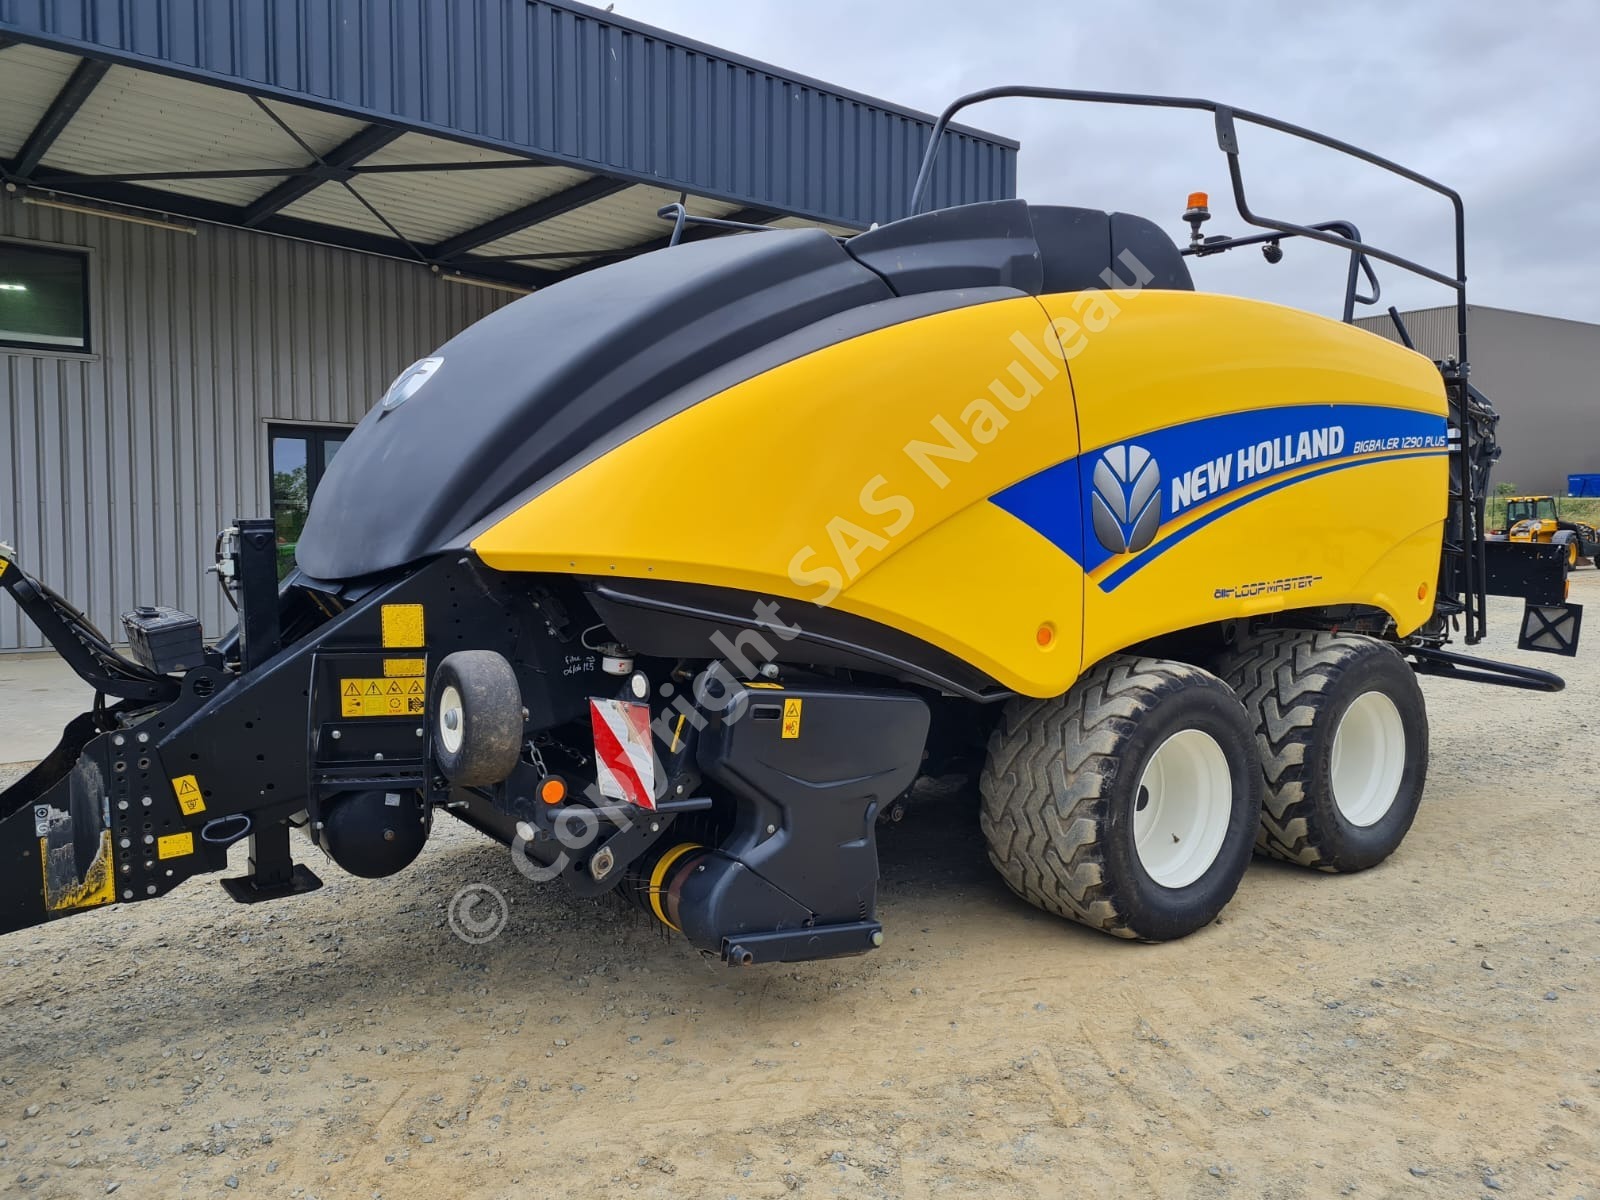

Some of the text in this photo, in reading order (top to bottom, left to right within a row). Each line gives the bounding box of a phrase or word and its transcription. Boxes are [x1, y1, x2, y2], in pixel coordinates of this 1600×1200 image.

[1172, 425, 1345, 514] NEW HOLLAND
[1353, 435, 1446, 454] BIGBALER 1290 PLUS
